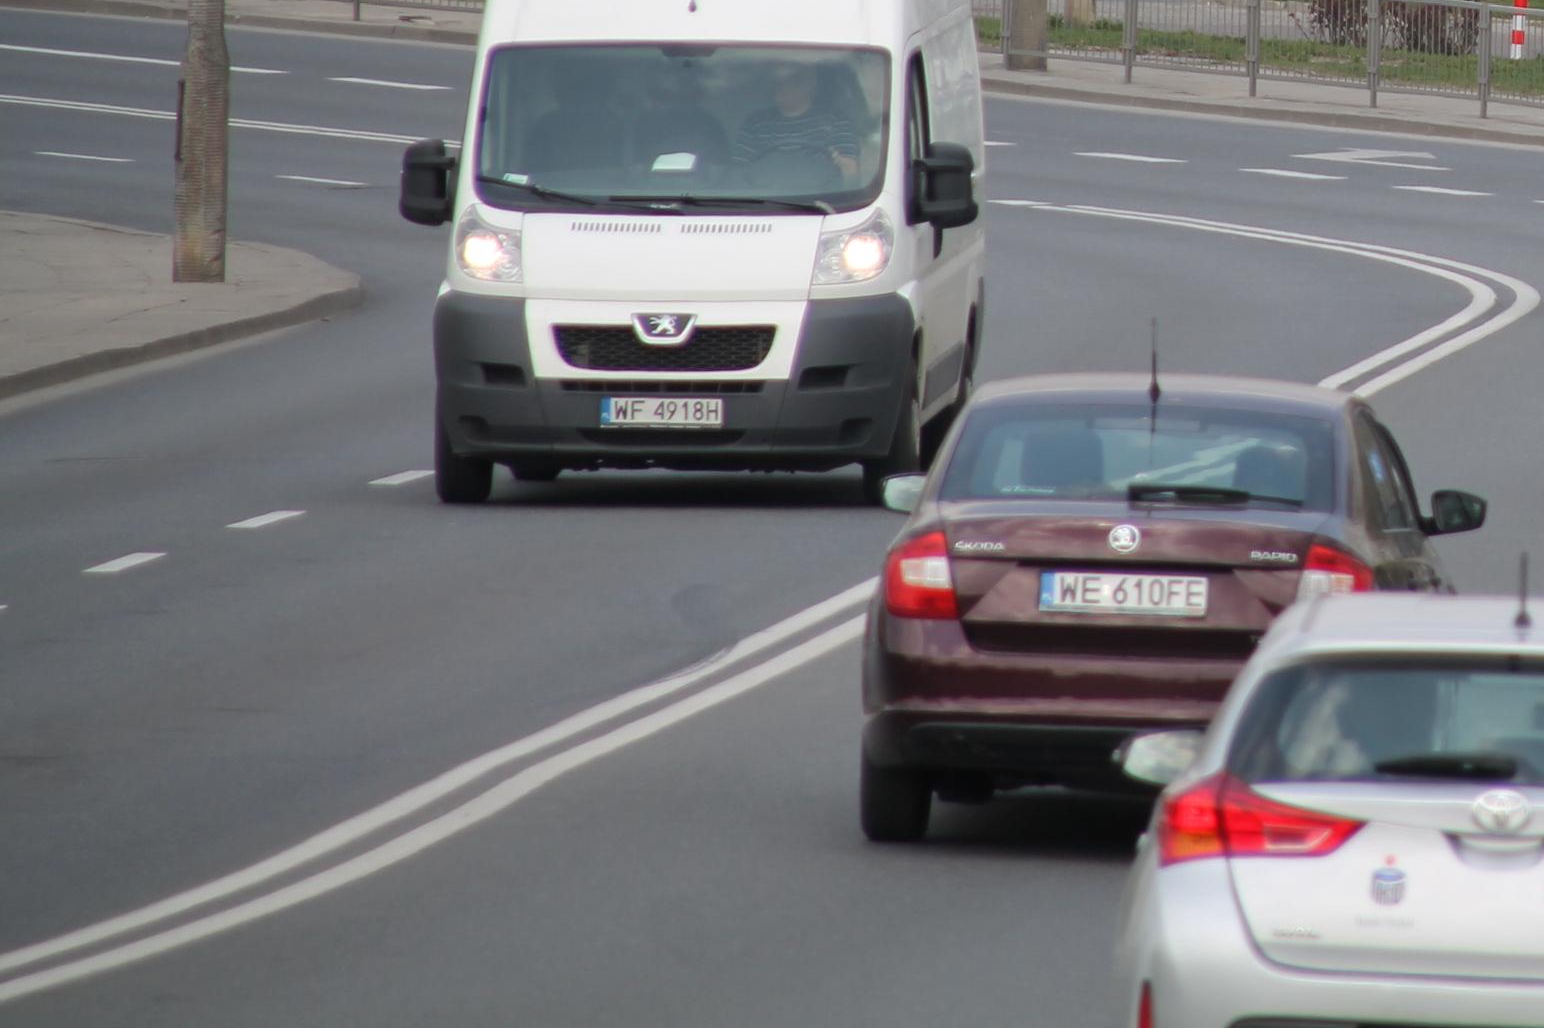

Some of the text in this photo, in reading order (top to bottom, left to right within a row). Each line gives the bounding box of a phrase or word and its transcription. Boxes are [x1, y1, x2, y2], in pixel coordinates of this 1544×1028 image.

[614, 399, 719, 422] WF 4918H
[1250, 550, 1298, 563] RAPID
[1059, 575, 1205, 608] WE 610FE
